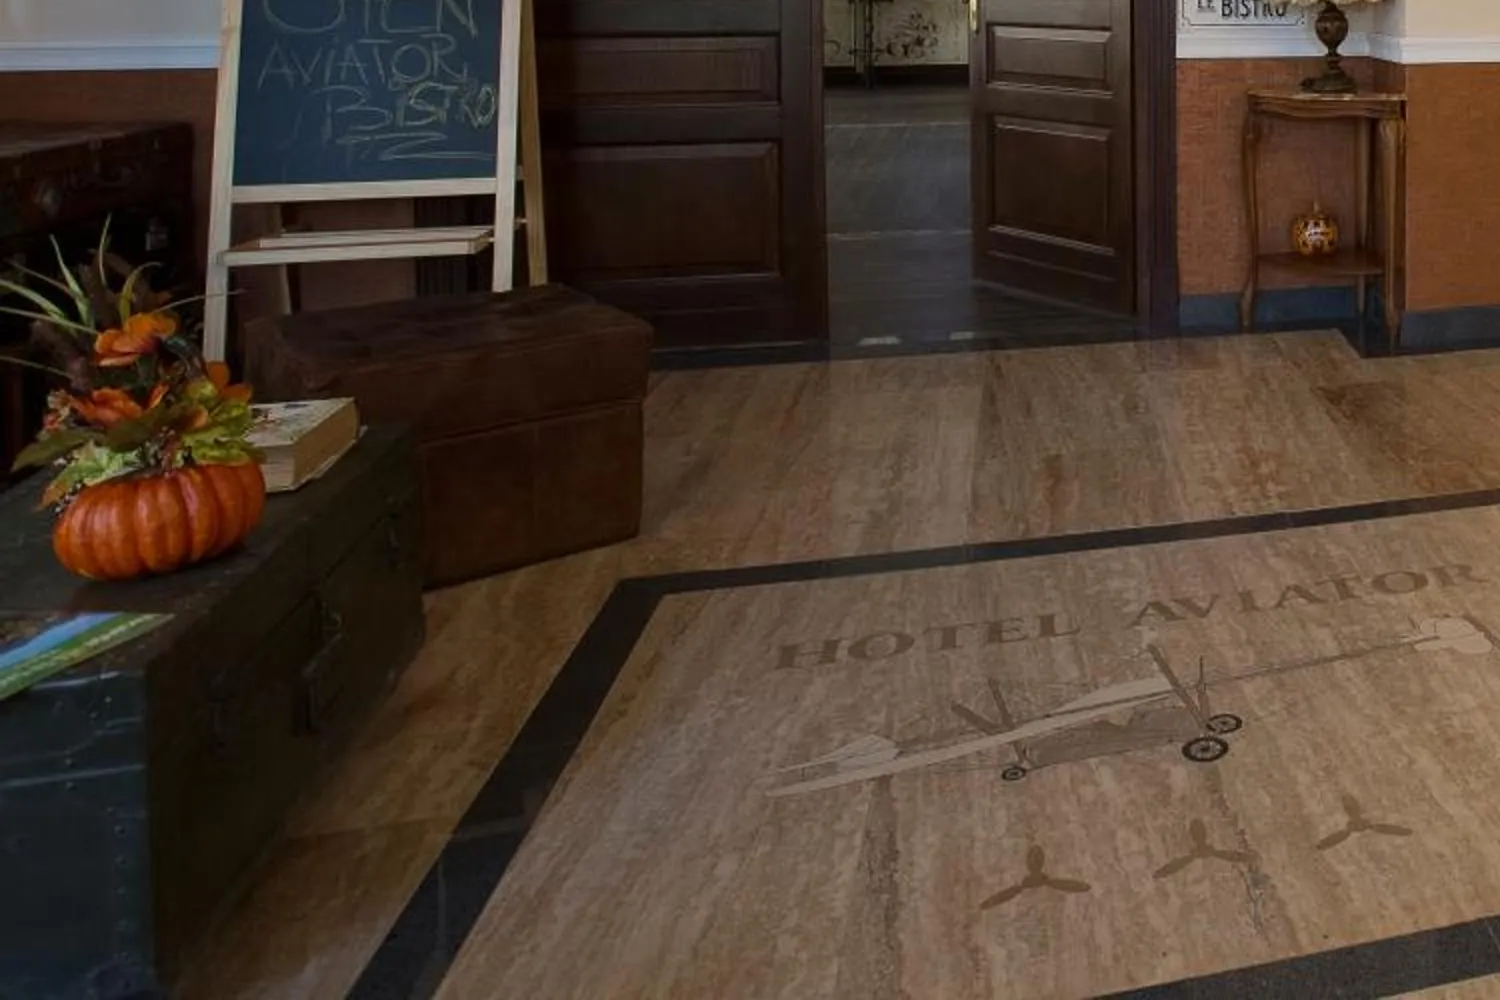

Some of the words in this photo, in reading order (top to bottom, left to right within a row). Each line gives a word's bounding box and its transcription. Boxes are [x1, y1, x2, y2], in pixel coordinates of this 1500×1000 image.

[257, 33, 468, 90] AVIATOR
[773, 613, 1080, 671] HOTEL
[1129, 562, 1490, 627] AVIATOR
